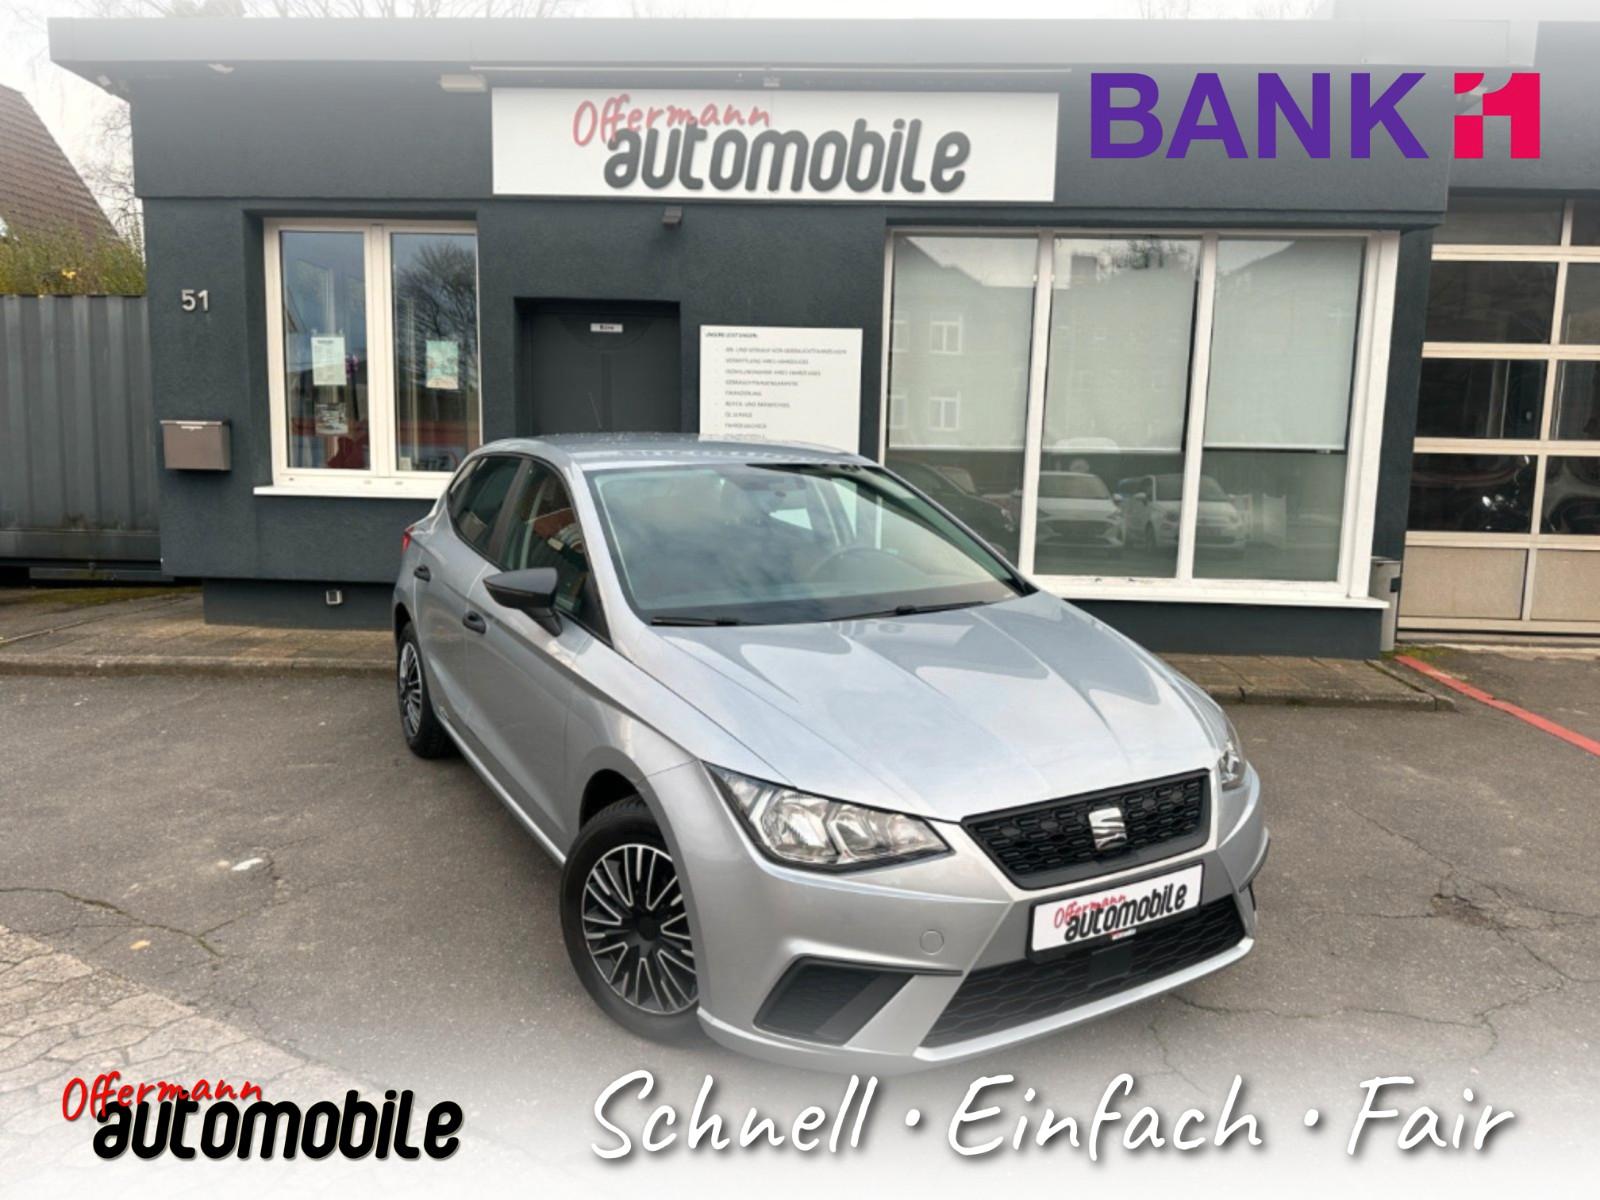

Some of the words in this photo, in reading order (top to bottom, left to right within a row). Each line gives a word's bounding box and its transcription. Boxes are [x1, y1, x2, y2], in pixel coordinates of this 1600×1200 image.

[573, 93, 770, 147] Offermann
[604, 118, 971, 193] automobile
[181, 289, 209, 311] 51
[1054, 894, 1127, 928] Offermann
[1064, 882, 1187, 942] automobile
